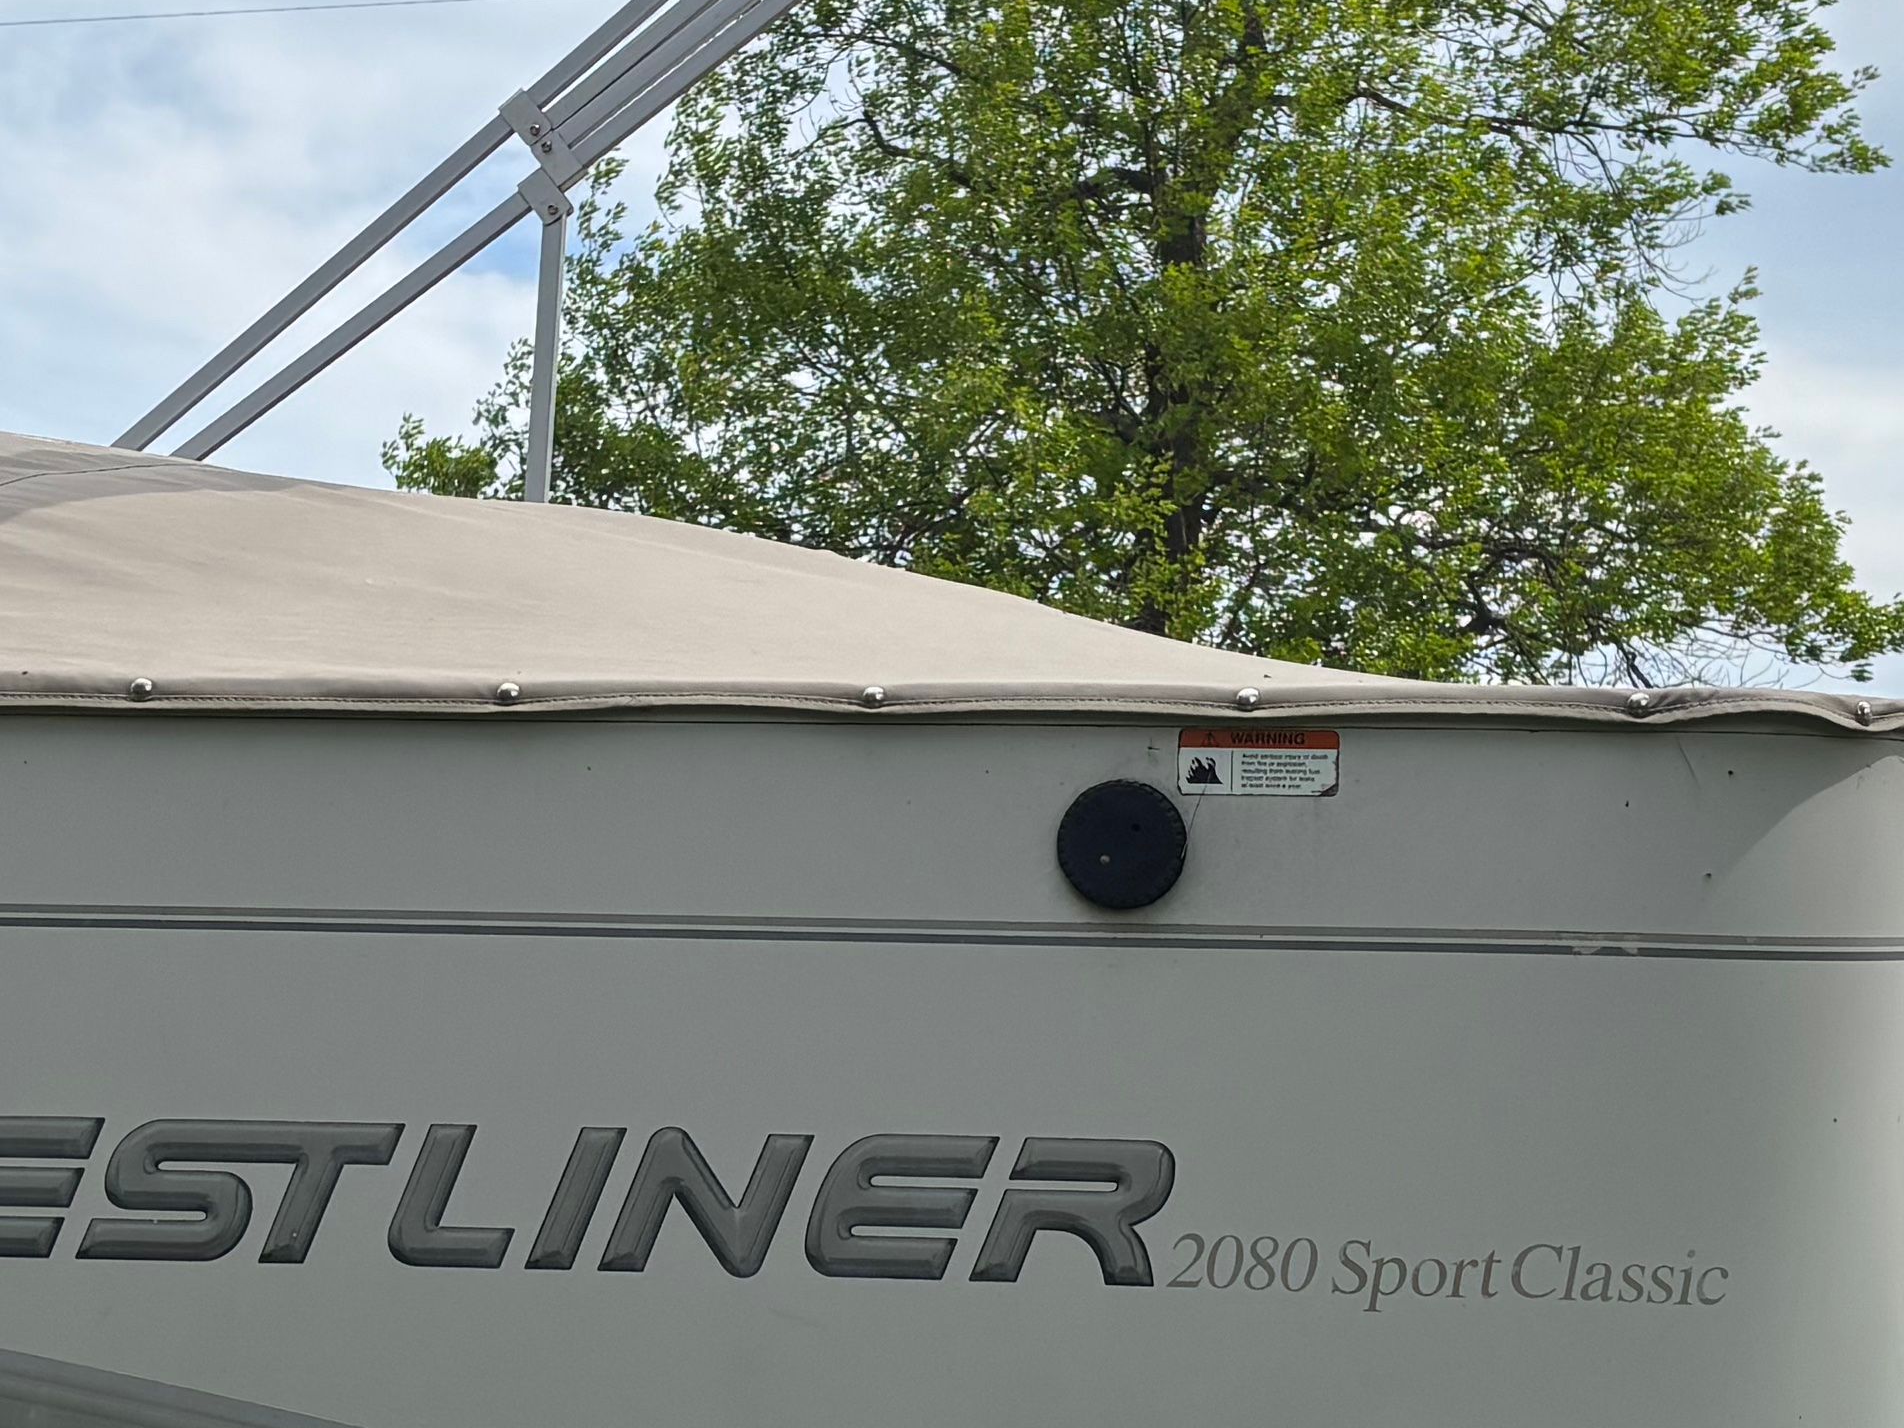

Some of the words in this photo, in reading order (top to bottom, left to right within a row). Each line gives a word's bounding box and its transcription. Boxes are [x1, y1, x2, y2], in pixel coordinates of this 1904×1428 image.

[1230, 732, 1306, 745] WARNING
[1166, 1231, 1319, 1294] 2080
[1330, 1238, 1503, 1313] Sport
[1510, 1243, 1730, 1307] Classic
